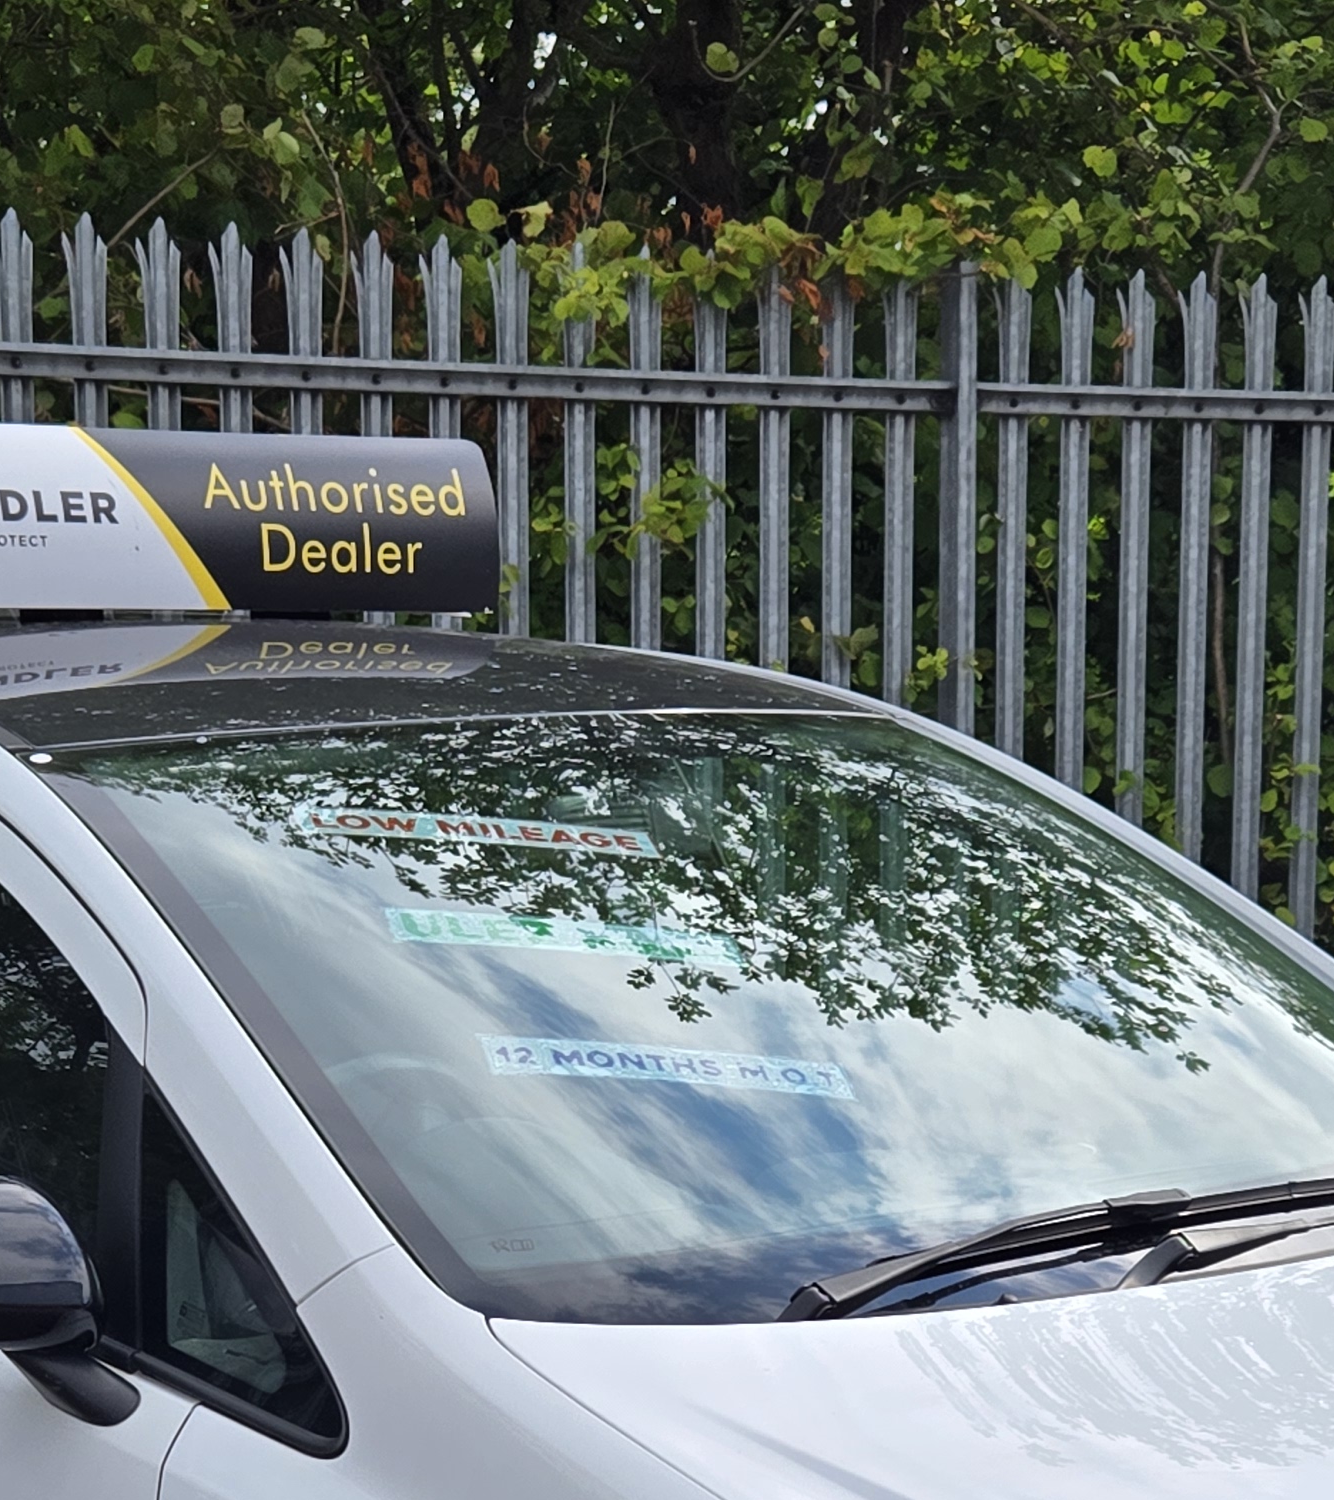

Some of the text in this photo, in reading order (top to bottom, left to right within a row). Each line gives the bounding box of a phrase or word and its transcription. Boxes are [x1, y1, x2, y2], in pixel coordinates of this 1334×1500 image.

[204, 462, 466, 516] Authorised
[260, 522, 423, 574] Dealer
[310, 812, 643, 852] LOW MILEAGE
[495, 1046, 536, 1064] 12
[551, 1048, 721, 1078] MONTHS
